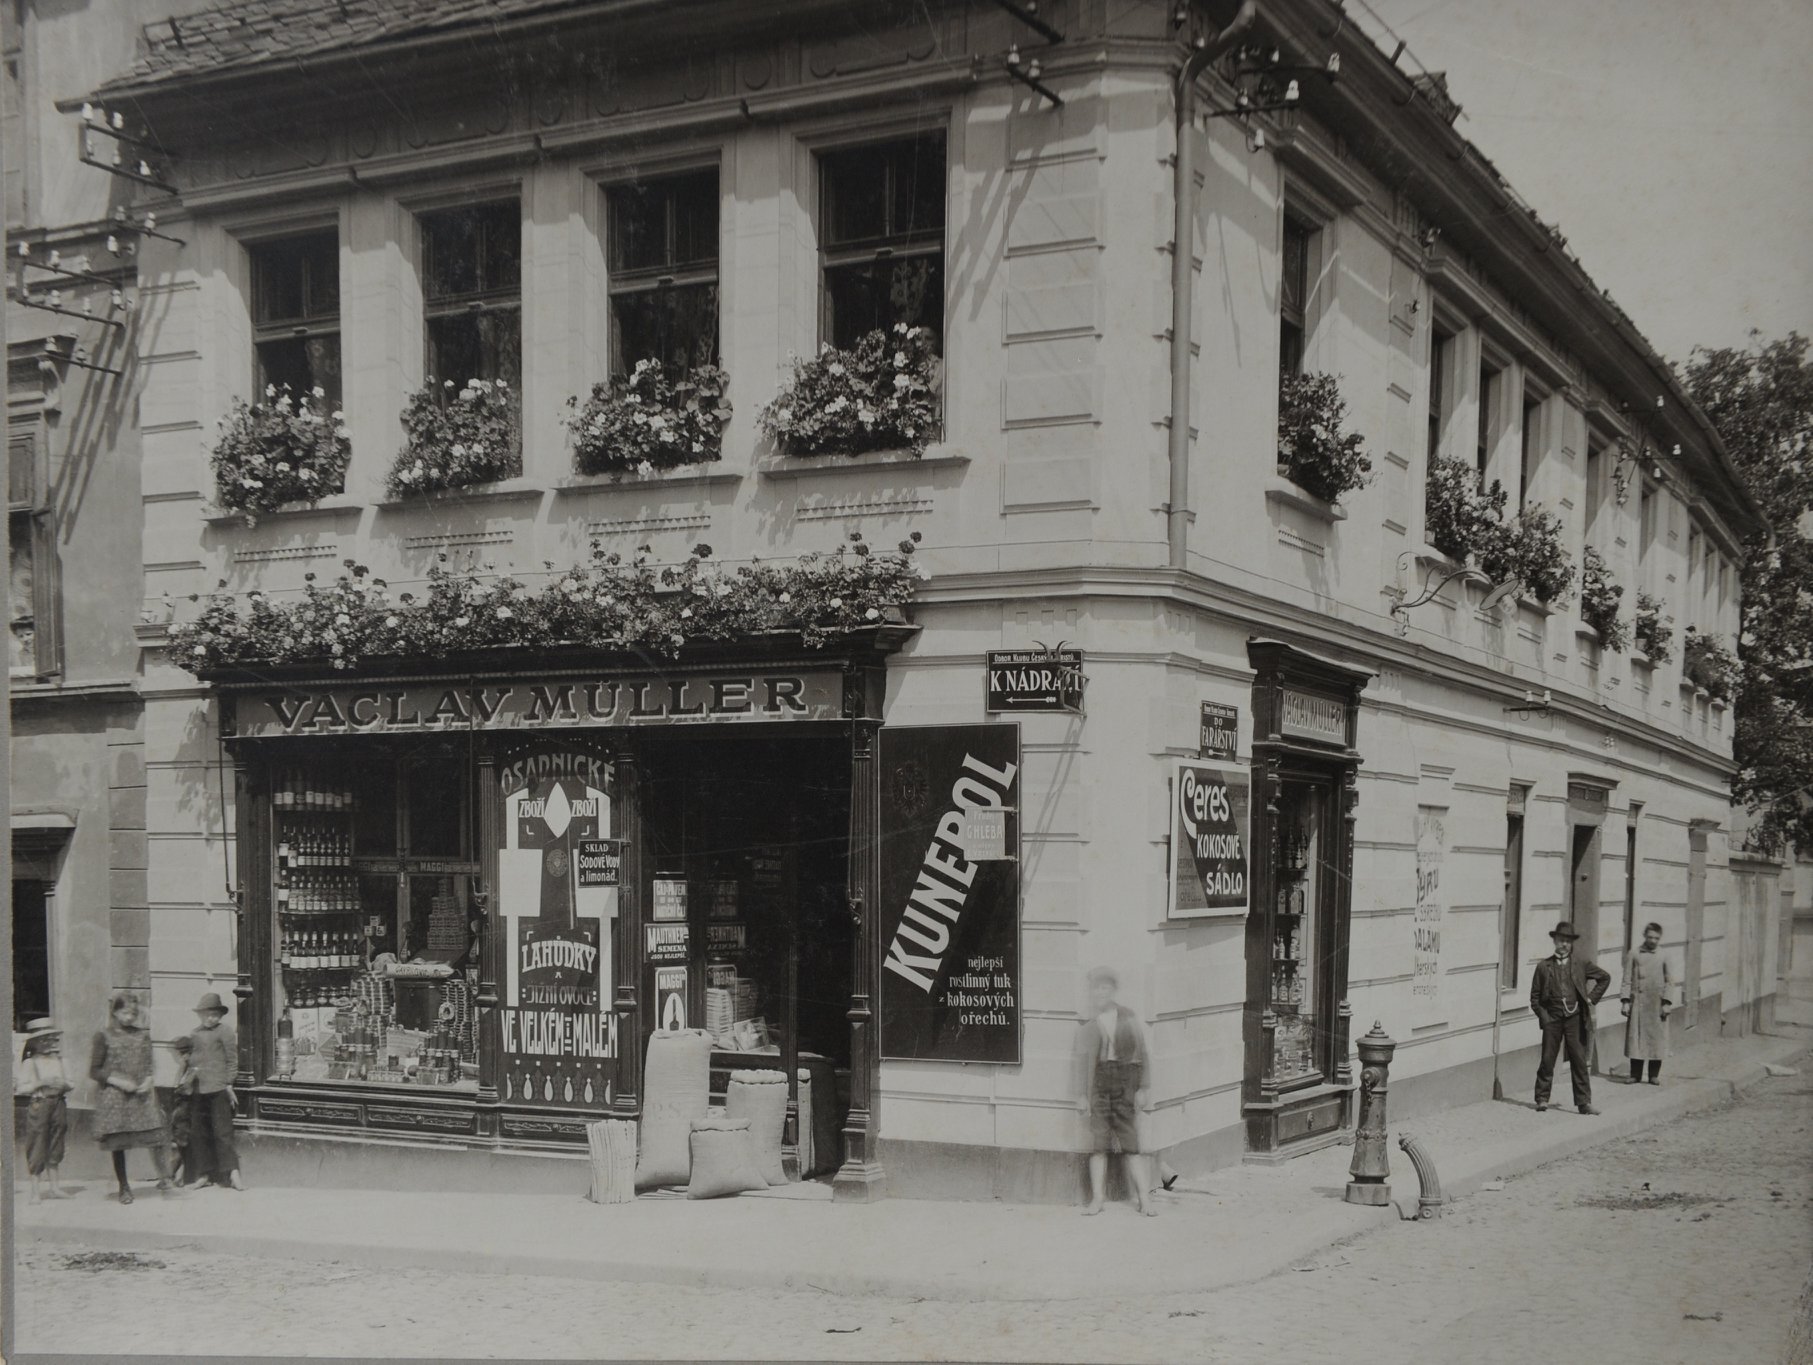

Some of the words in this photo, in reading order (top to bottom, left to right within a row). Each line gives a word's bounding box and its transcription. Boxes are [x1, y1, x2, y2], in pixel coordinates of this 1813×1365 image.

[990, 671, 1002, 692] K
[1005, 664, 1081, 692] NÁDRAÍ
[523, 677, 809, 722] MÜLLER
[1214, 716, 1223, 726] DO
[501, 753, 616, 796] OSADNICKÉ
[1180, 768, 1230, 839] Ceres
[585, 844, 609, 852] SKLAD
[1196, 831, 1241, 860] KOKOSOVÉ
[419, 862, 445, 872] MAGGI
[580, 874, 585, 882] a
[1206, 863, 1243, 896] SÁDLO
[968, 956, 1004, 971] nejlepší
[949, 973, 990, 991] rostlinný
[994, 973, 1011, 988] tuk
[947, 991, 1015, 1010] kokosových
[500, 1010, 517, 1053] VE
[519, 1007, 564, 1055] VELKÉM
[573, 1011, 618, 1058] MALÉM
